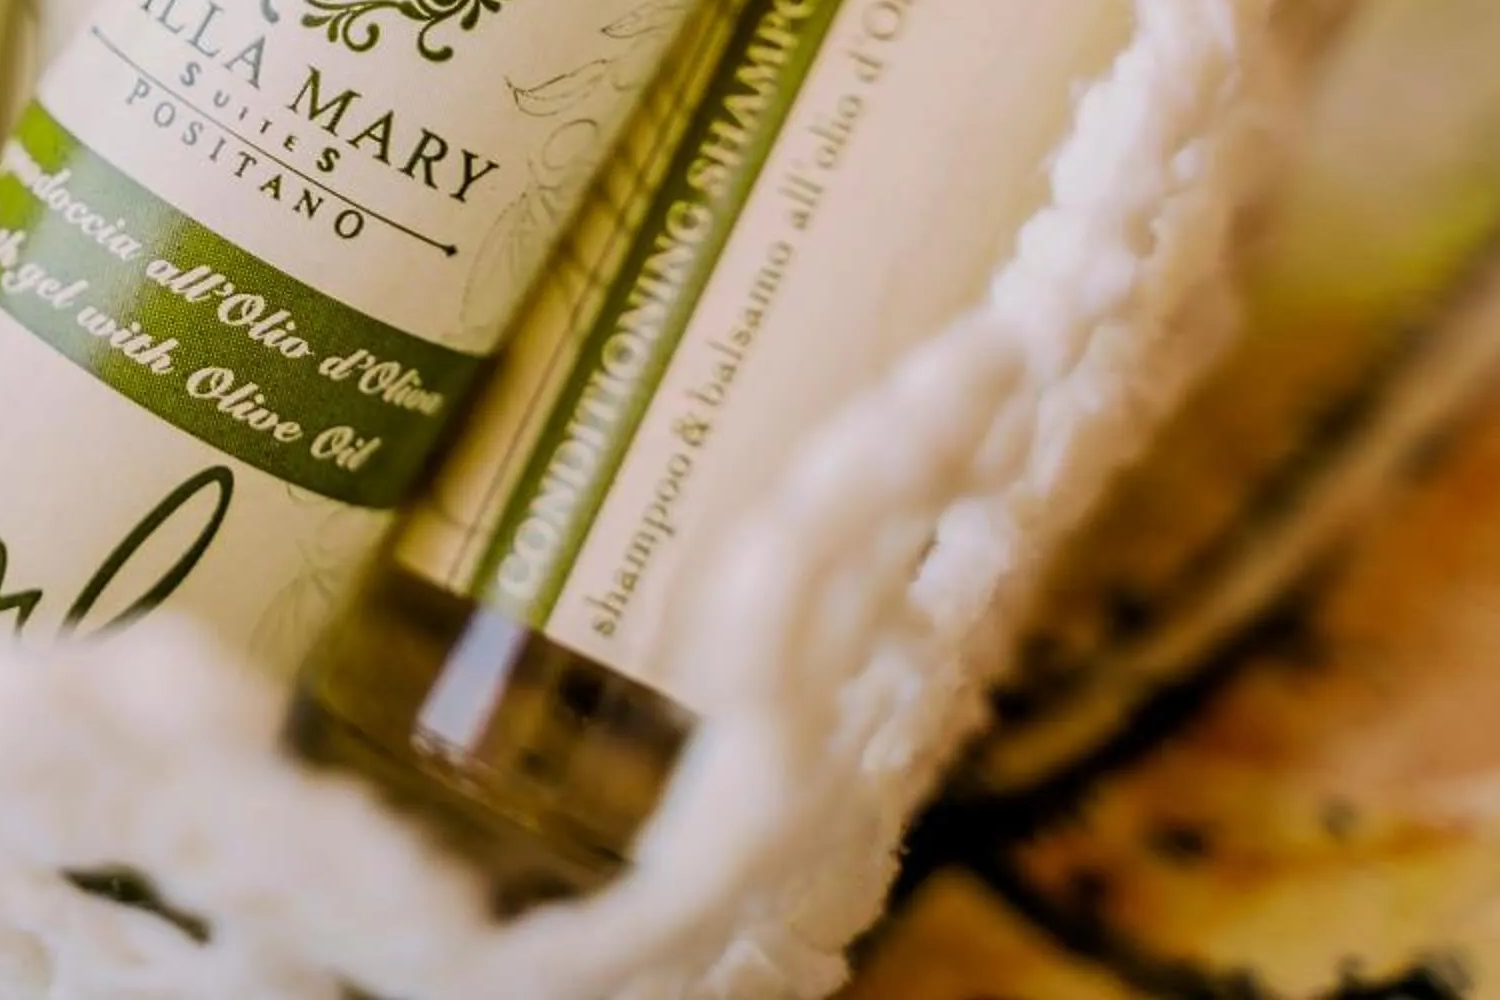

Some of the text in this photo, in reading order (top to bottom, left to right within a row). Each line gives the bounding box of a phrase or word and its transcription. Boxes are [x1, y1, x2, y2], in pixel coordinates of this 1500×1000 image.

[124, 77, 366, 240] POSITANO
[286, 64, 500, 204] MARY
[1, 262, 90, 310] gel
[76, 305, 180, 376] with
[186, 365, 305, 443] Olive
[309, 425, 383, 473] Oil
[145, 257, 314, 360] all'Olio
[687, 240, 795, 408] balsamo
[498, 199, 714, 597] CONDITIONING
[671, 412, 713, 449] &
[582, 449, 694, 637] shampoo
